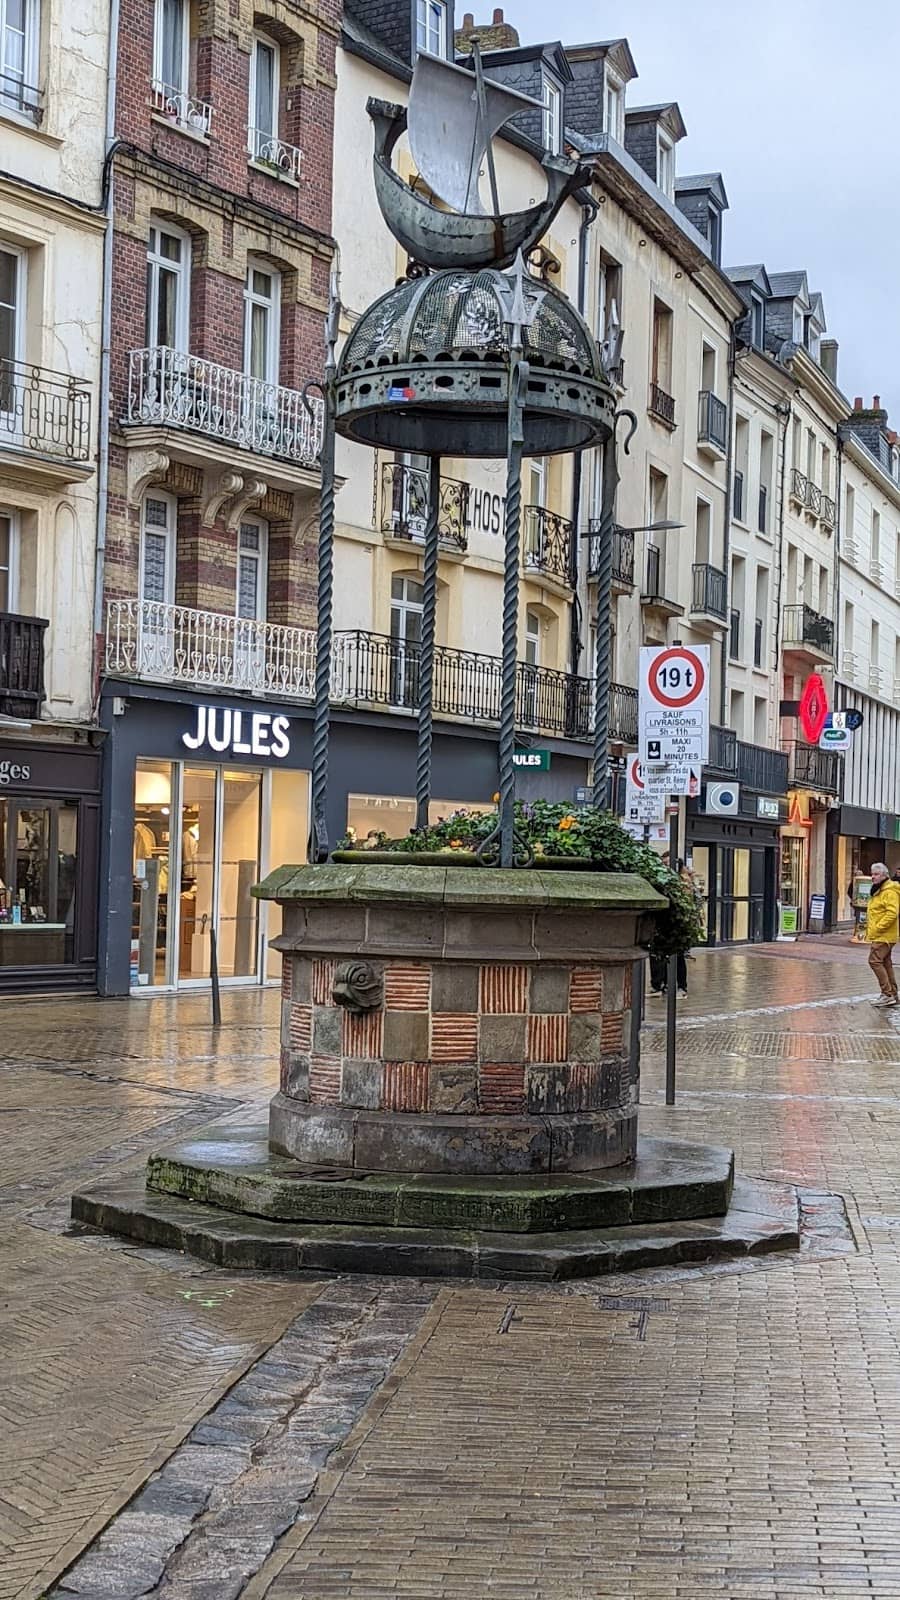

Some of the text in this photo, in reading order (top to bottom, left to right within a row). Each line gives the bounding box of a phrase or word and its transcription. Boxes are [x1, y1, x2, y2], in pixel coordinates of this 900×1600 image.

[659, 667, 693, 688] 19 t
[662, 711, 684, 719] SAUF
[649, 718, 697, 727] LIVRAISONS
[182, 706, 290, 758] JULES
[659, 728, 669, 736] 5h
[675, 727, 689, 737] 11h
[677, 745, 686, 753] 20
[0, 761, 31, 785] ges
